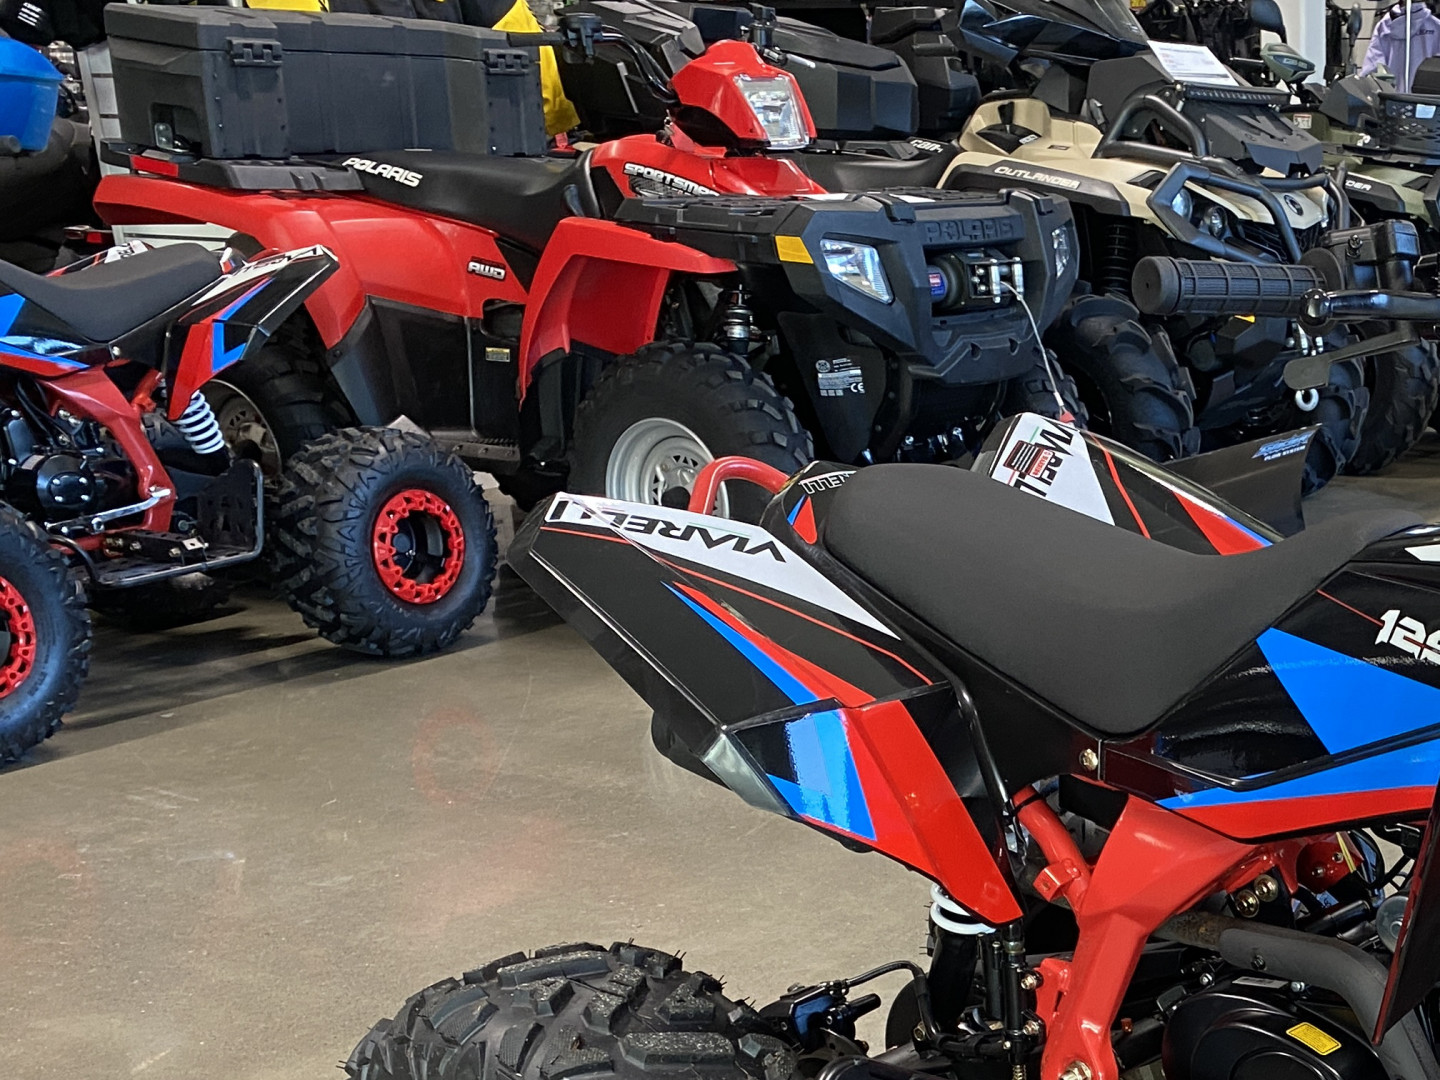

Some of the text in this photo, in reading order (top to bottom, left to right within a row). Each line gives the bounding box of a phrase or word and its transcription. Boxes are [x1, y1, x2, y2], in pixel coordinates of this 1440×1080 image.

[341, 157, 423, 188] POLARIS
[994, 166, 1071, 190] OUTLANDER
[467, 261, 506, 280] AWD
